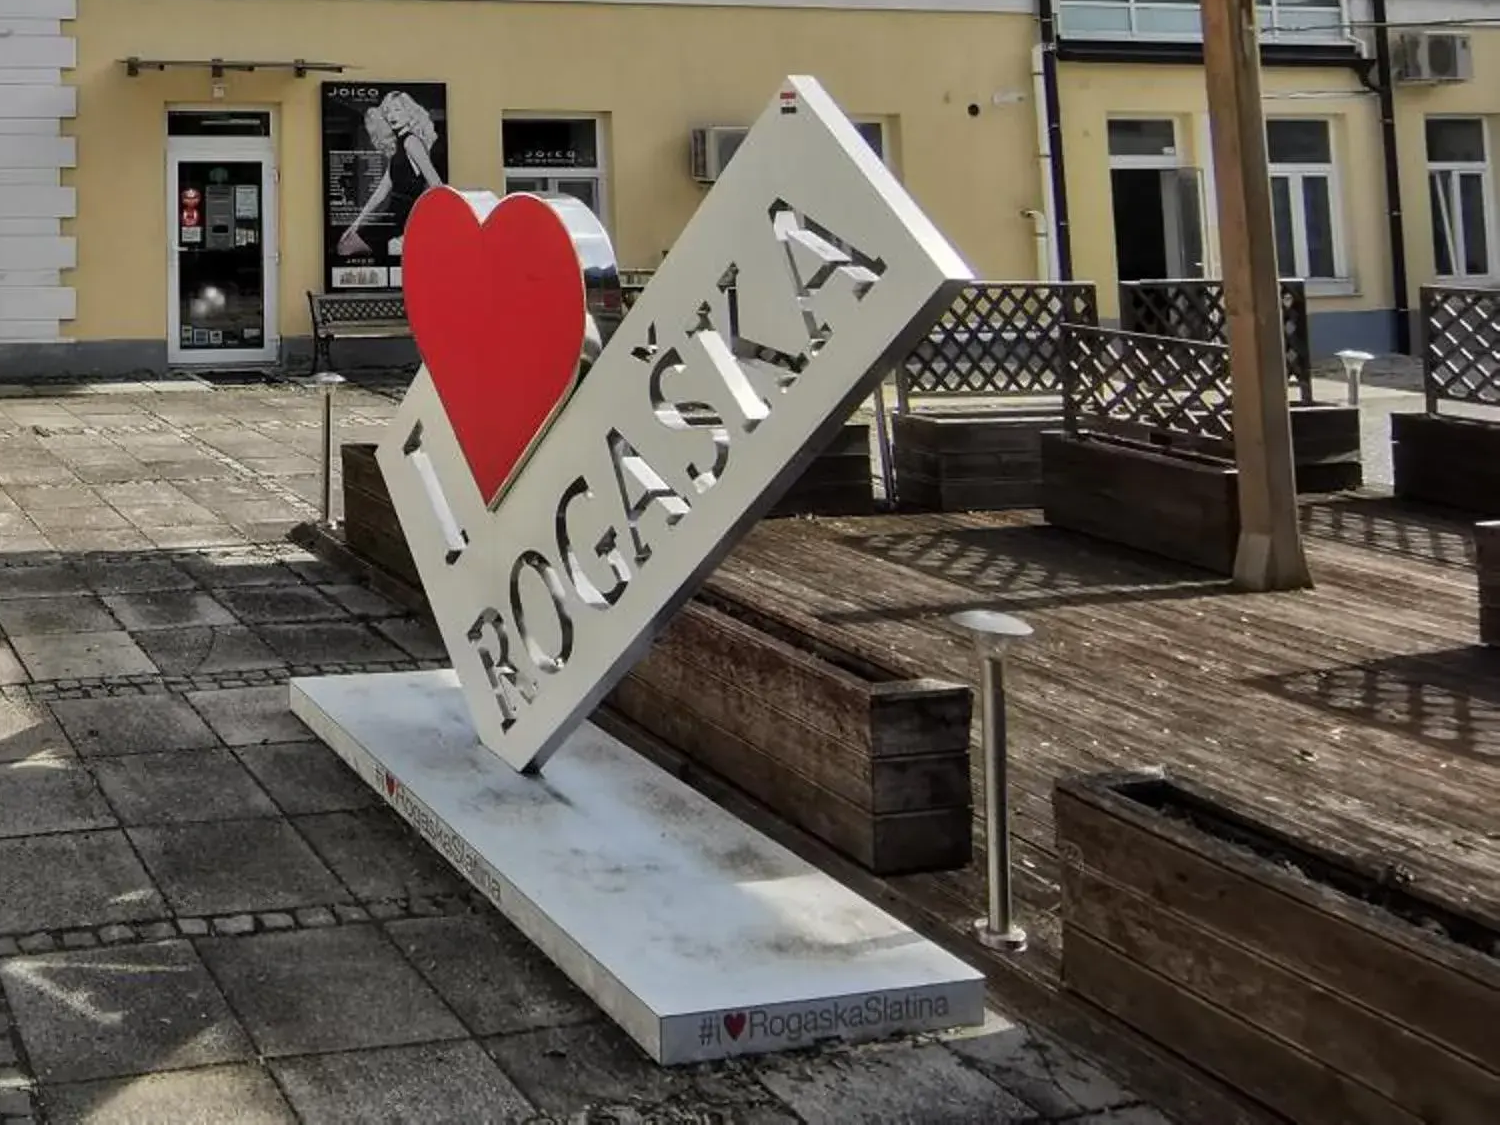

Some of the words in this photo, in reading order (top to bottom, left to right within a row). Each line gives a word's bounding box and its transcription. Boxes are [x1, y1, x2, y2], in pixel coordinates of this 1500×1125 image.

[327, 87, 379, 97] JOICO
[403, 418, 470, 566] I
[467, 196, 888, 735] ROGAŠKA
[749, 994, 949, 1042] RogaskaSlatina
